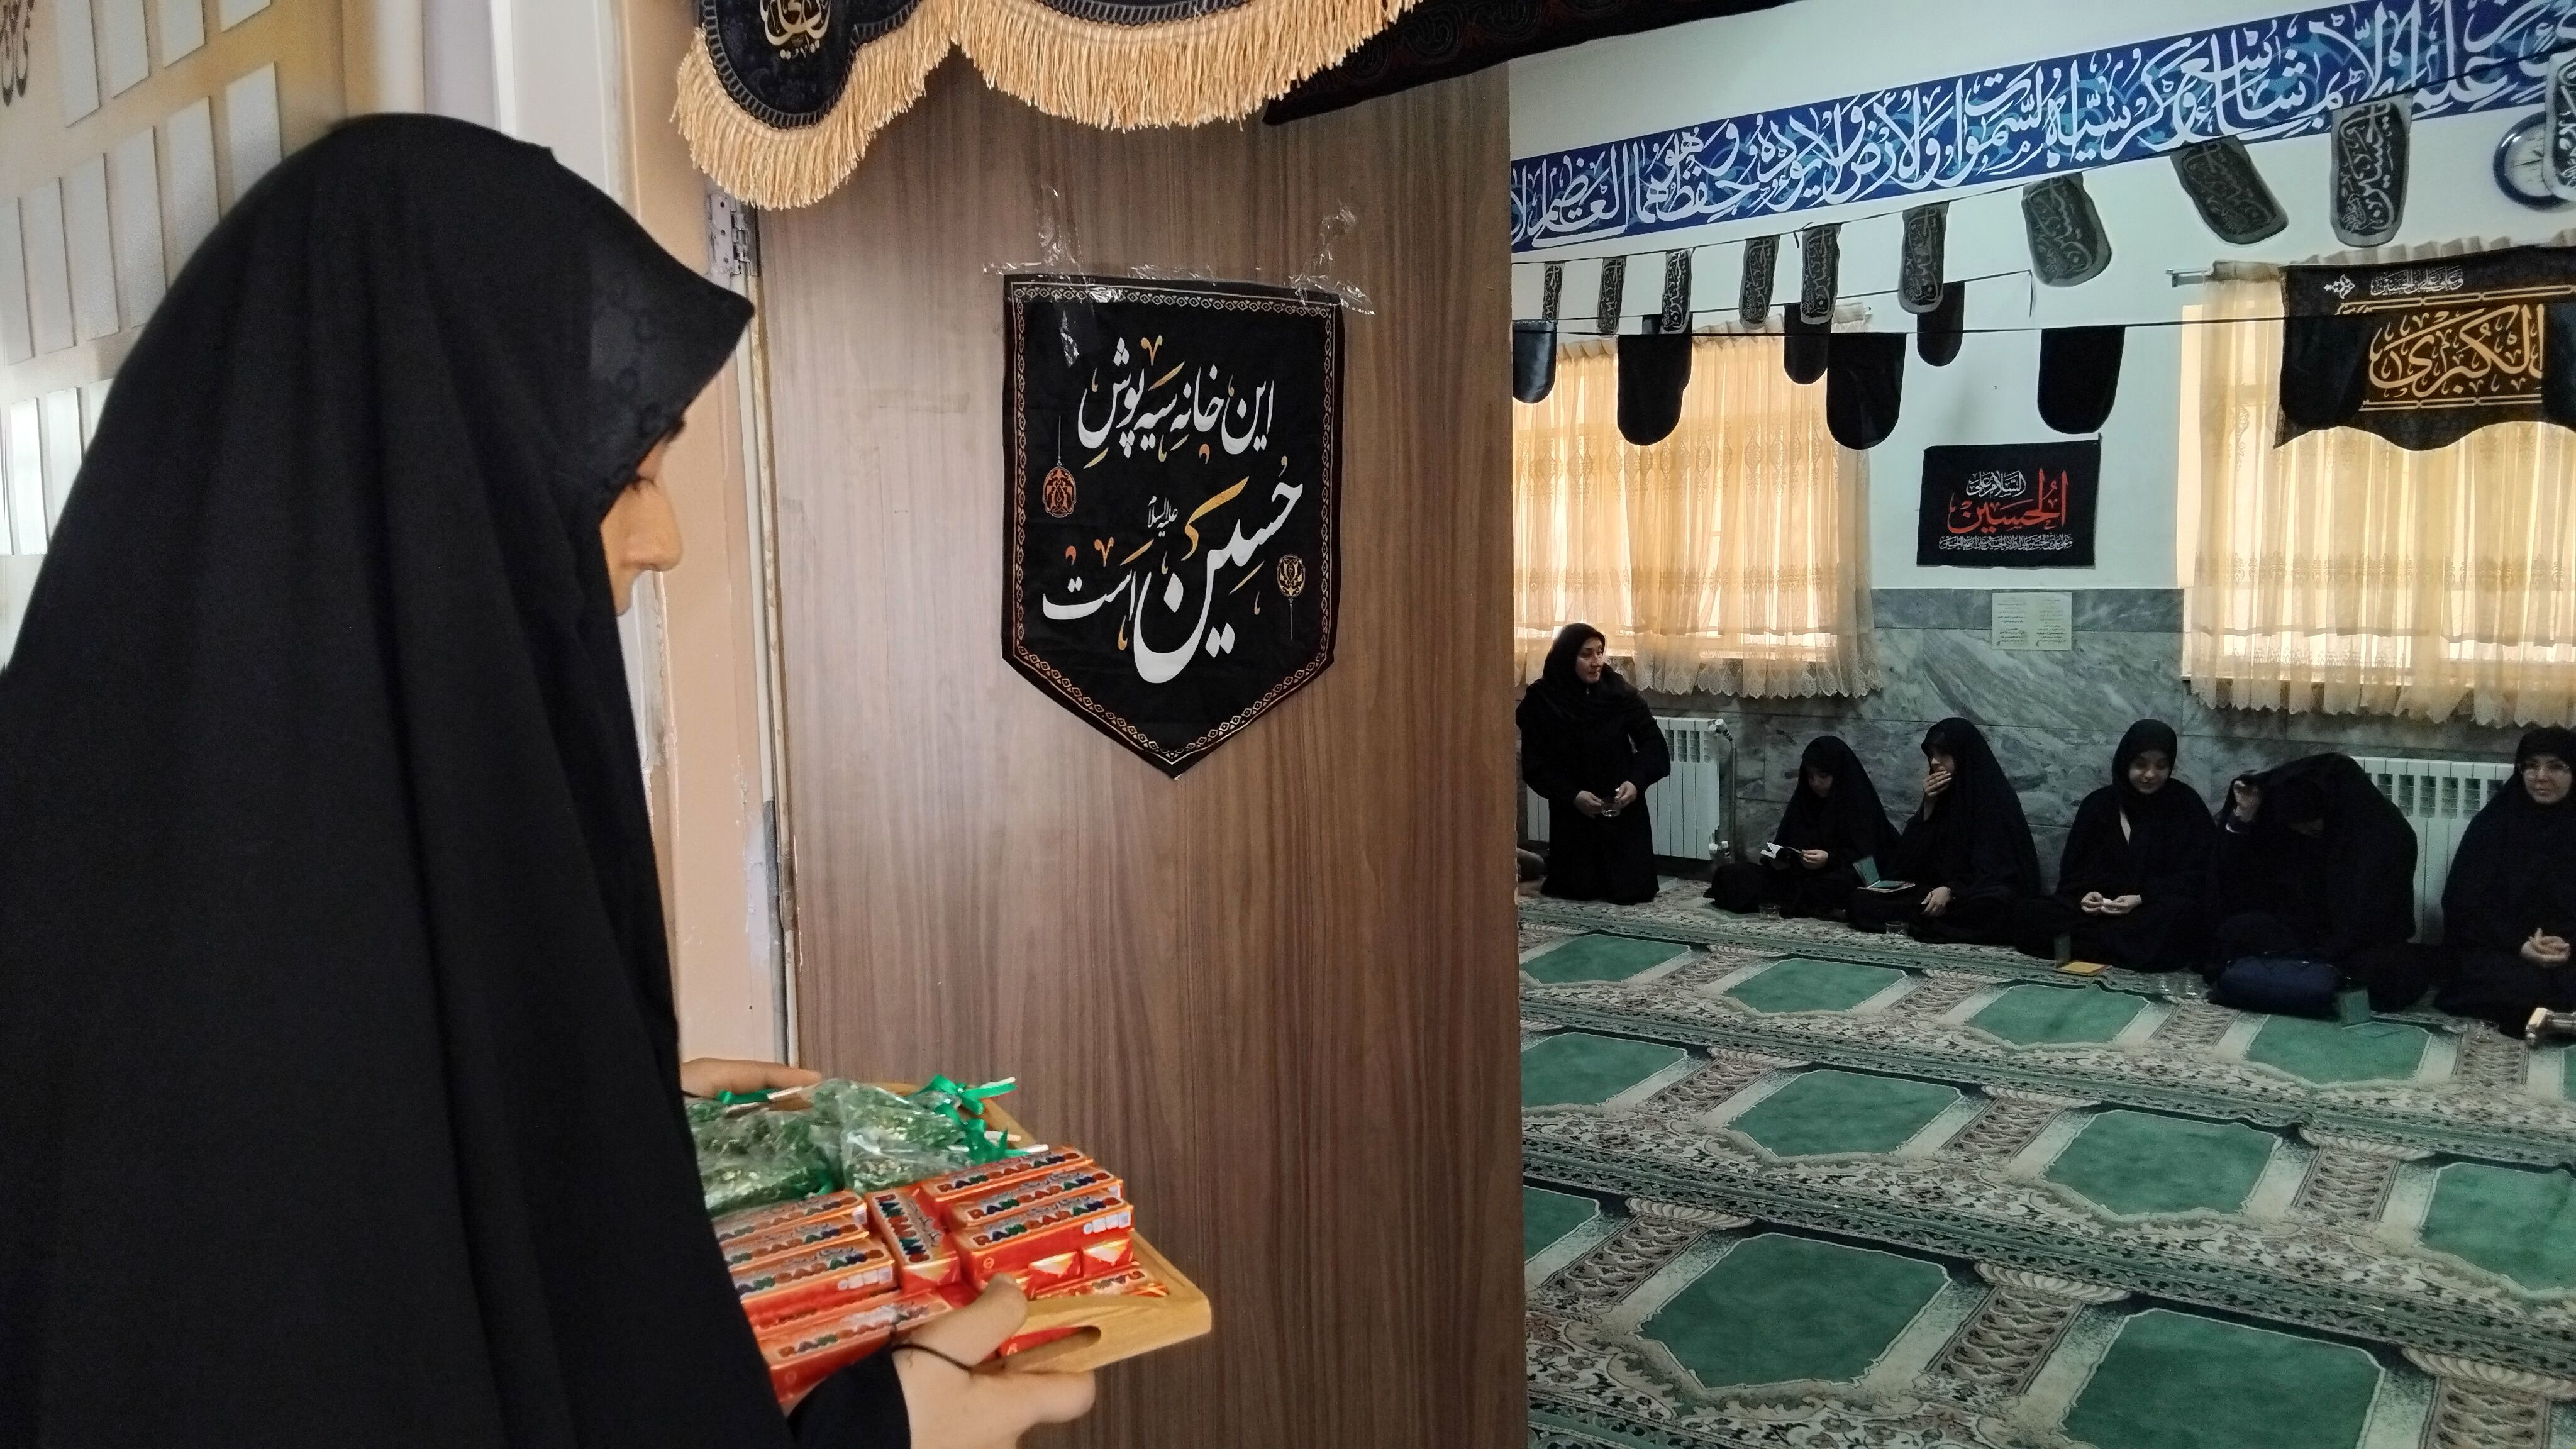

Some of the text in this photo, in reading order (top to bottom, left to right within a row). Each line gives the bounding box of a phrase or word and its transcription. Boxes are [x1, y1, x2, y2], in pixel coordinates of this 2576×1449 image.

[1170, 364, 1225, 434] خانه
[1221, 380, 1275, 455] این
[1042, 482, 1304, 684] حسین است
